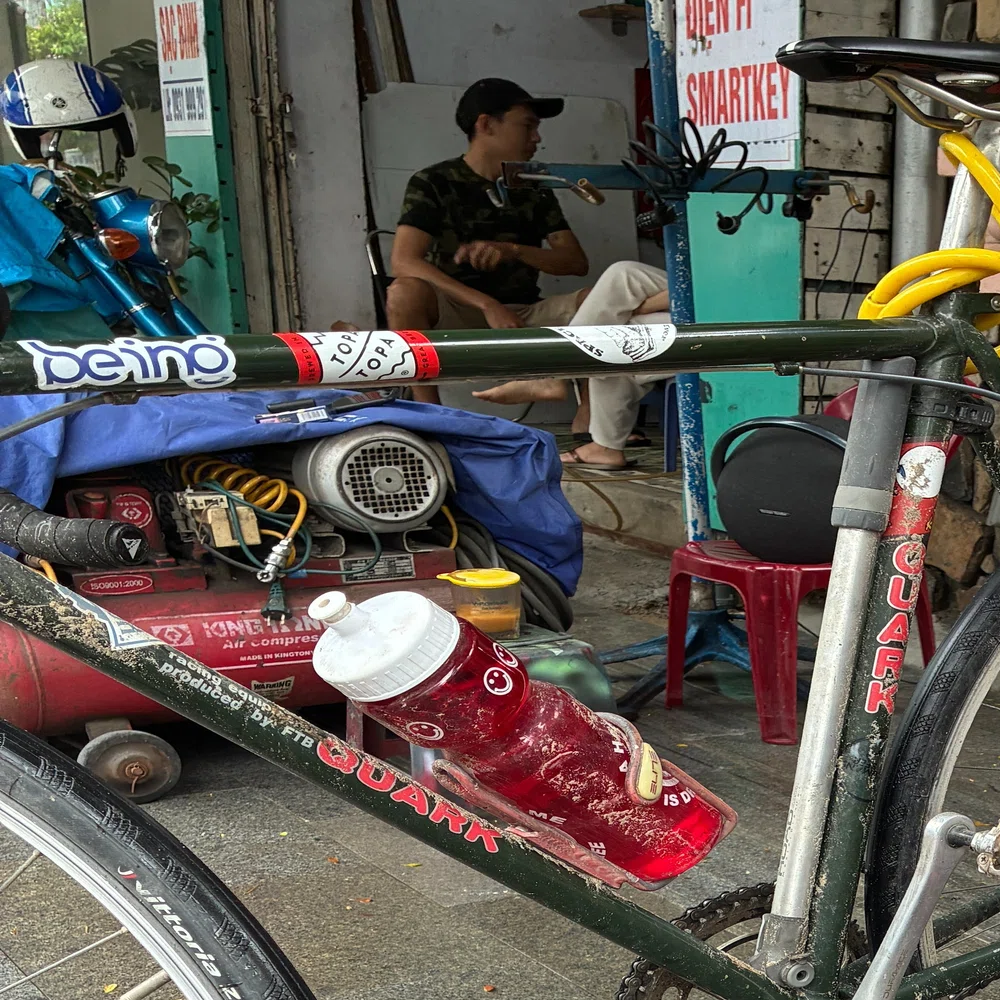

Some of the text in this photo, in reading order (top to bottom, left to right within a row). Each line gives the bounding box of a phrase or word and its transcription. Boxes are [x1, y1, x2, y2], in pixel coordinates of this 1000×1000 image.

[686, 62, 790, 127] SMARTKEY
[27, 336, 229, 385] being
[355, 338, 396, 377] TOPA
[865, 540, 926, 714] QUARK
[159, 662, 273, 728] produced by
[169, 651, 222, 687] racing
[281, 726, 315, 749] FTB
[316, 736, 503, 853] QUARK
